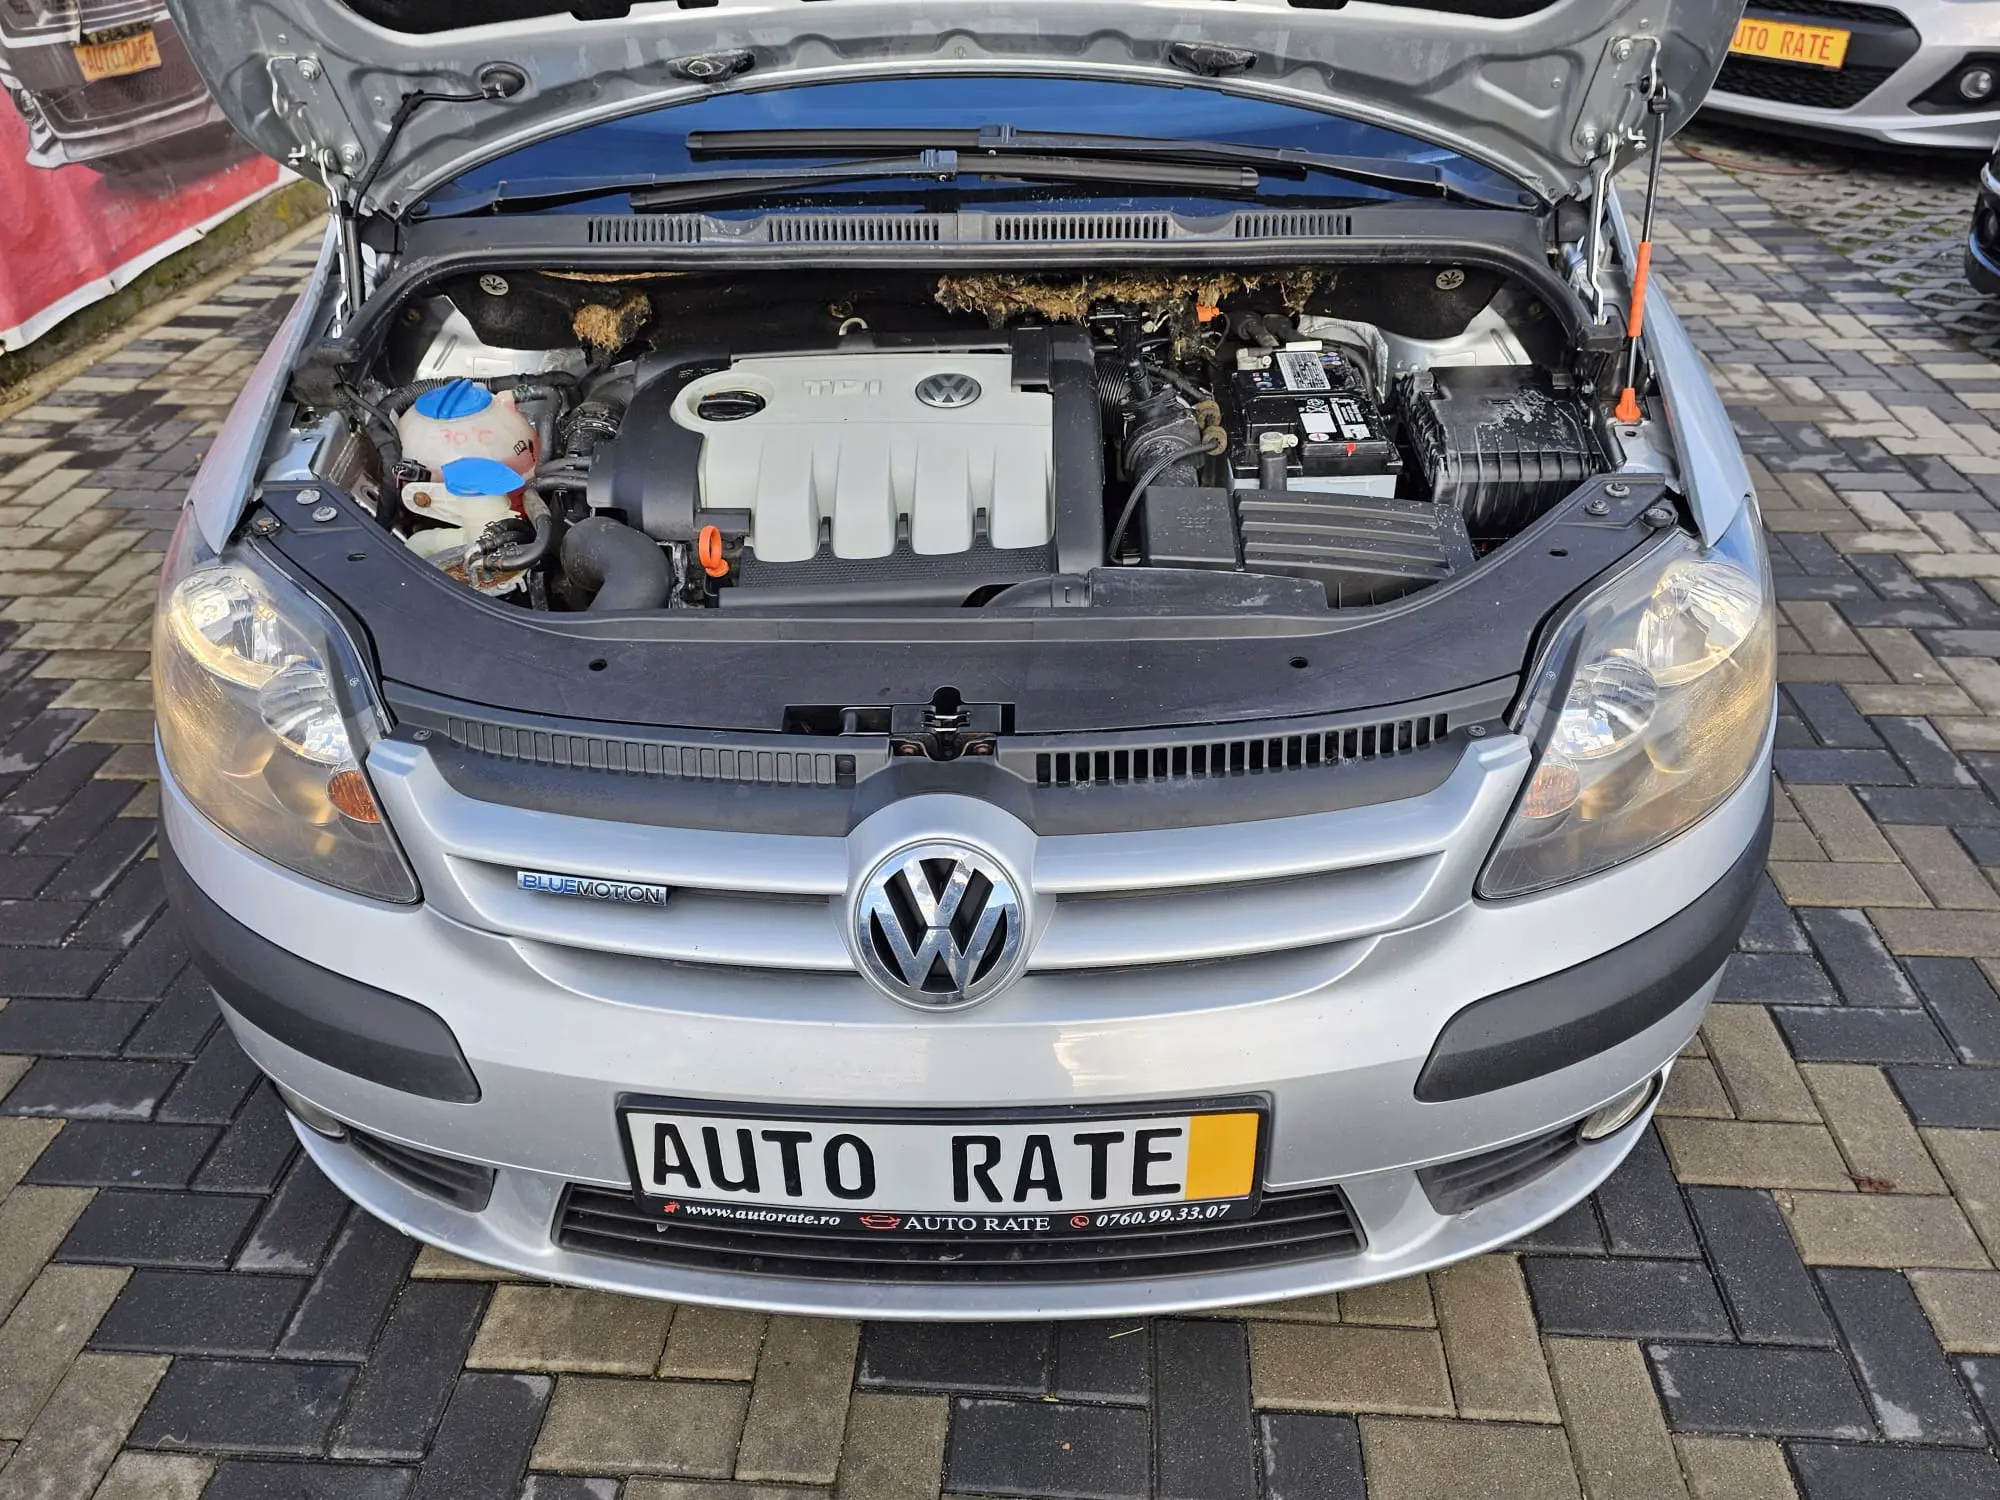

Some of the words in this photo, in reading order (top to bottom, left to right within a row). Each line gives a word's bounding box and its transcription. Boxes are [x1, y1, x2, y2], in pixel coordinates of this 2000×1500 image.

[1733, 26, 1769, 51] UTO
[1780, 30, 1835, 61] RATE
[801, 378, 883, 397] TDI
[522, 873, 661, 905] BLUEMOTION
[653, 1122, 876, 1200] AUTO
[952, 1127, 1183, 1203] RATE
[685, 1203, 841, 1227] www.autorate.ro
[903, 1216, 977, 1232] AUTO
[983, 1216, 1051, 1232] RATE
[1095, 1203, 1231, 1228] 0760.99.33.07
